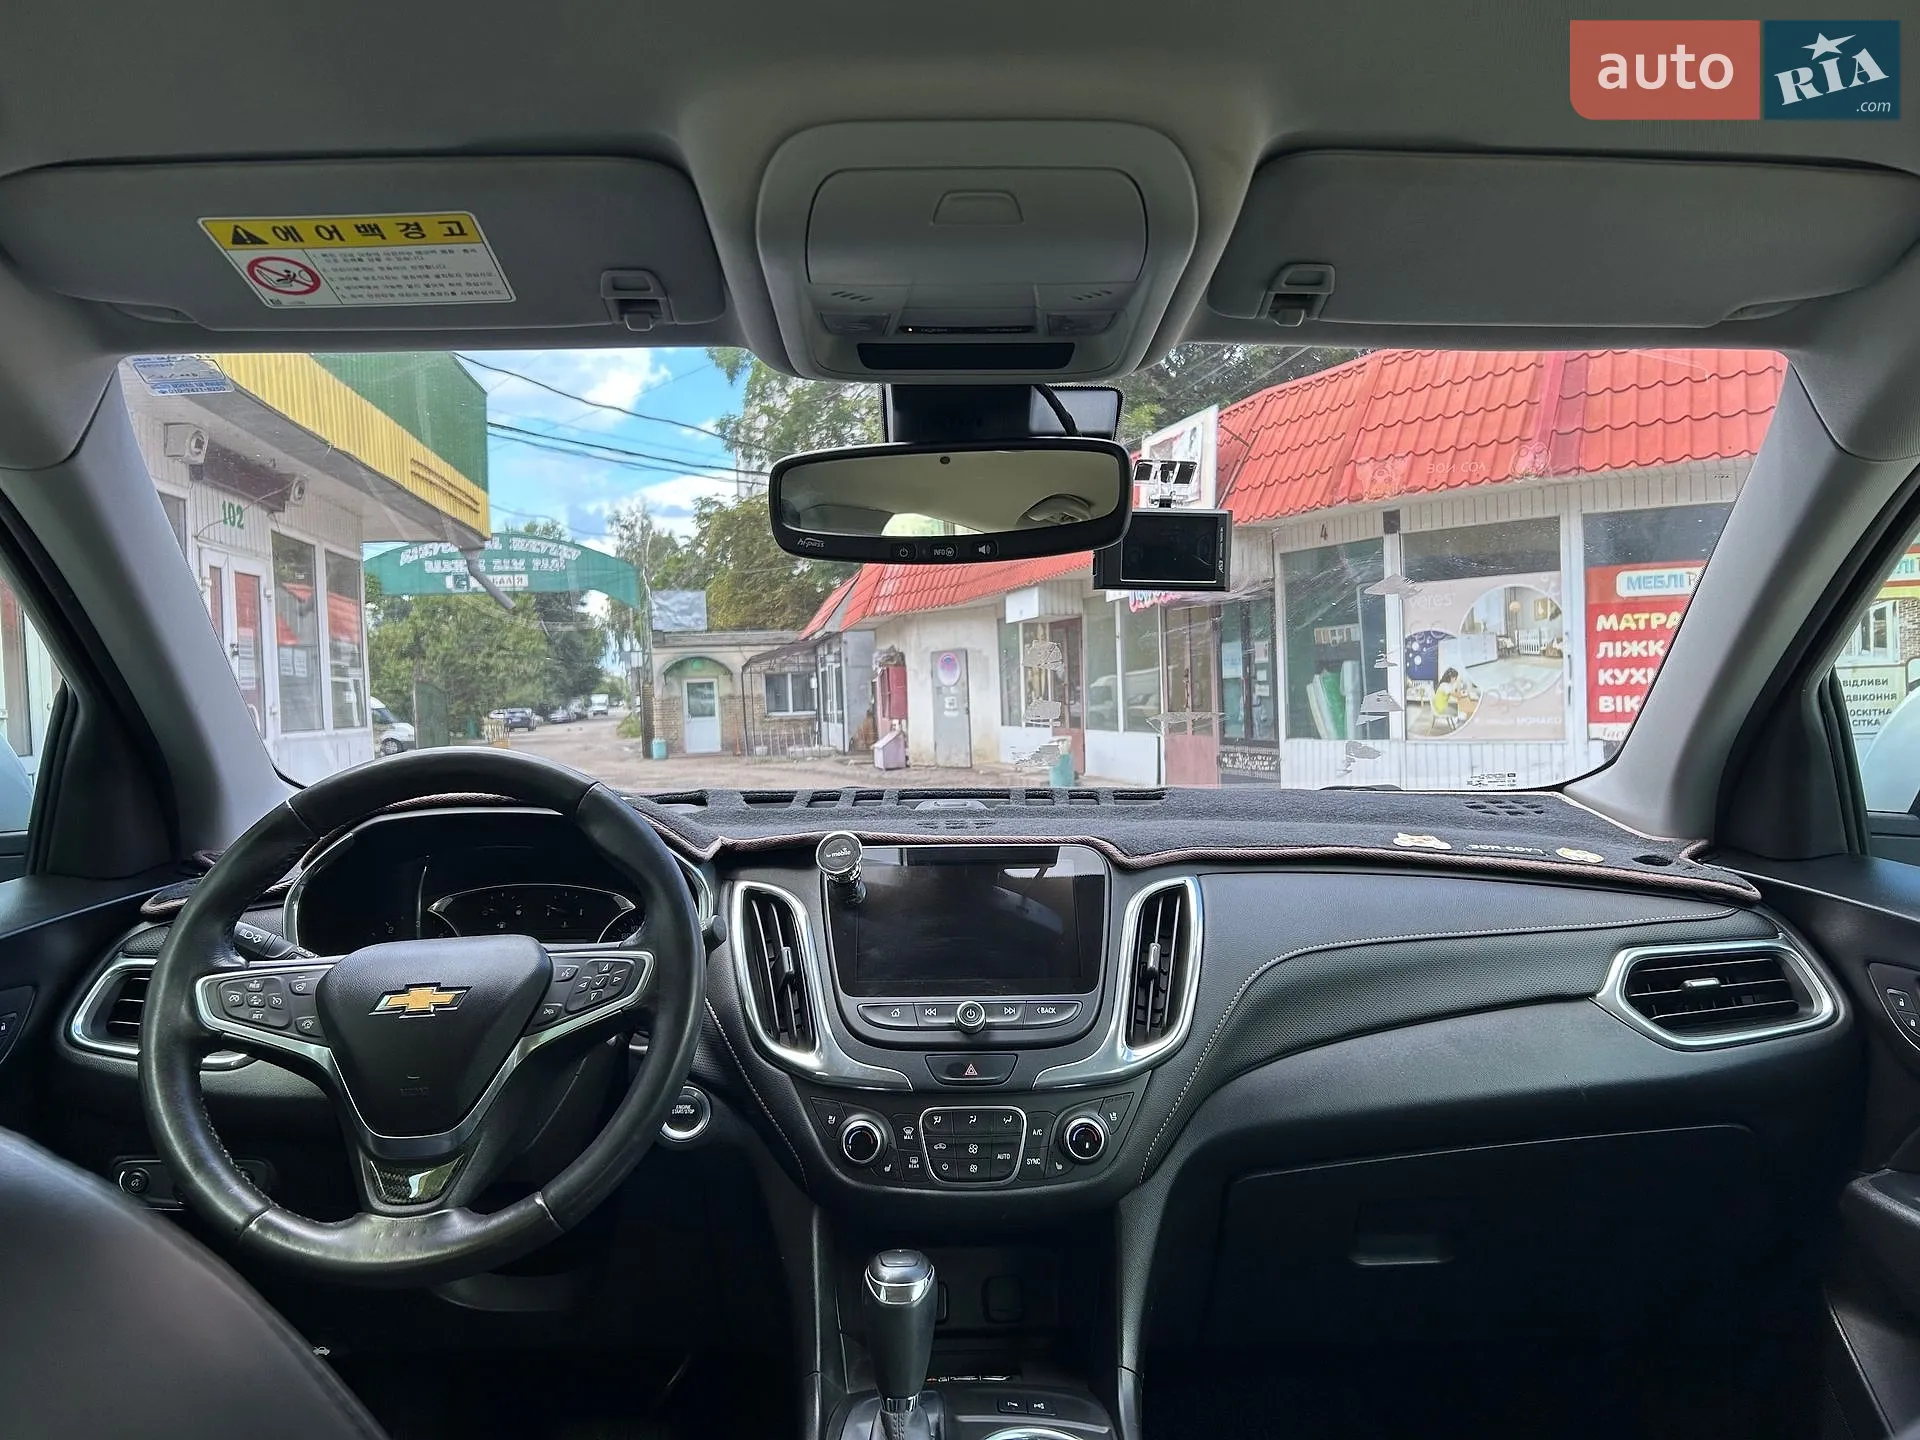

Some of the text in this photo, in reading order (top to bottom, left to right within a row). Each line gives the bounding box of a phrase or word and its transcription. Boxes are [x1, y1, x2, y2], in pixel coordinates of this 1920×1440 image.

[222, 500, 244, 530] 102
[1320, 524, 1328, 541] 4
[1625, 574, 1685, 592] МЕБЛІ
[1598, 695, 1643, 713] ВІК
[1852, 719, 1881, 728] СІТКА
